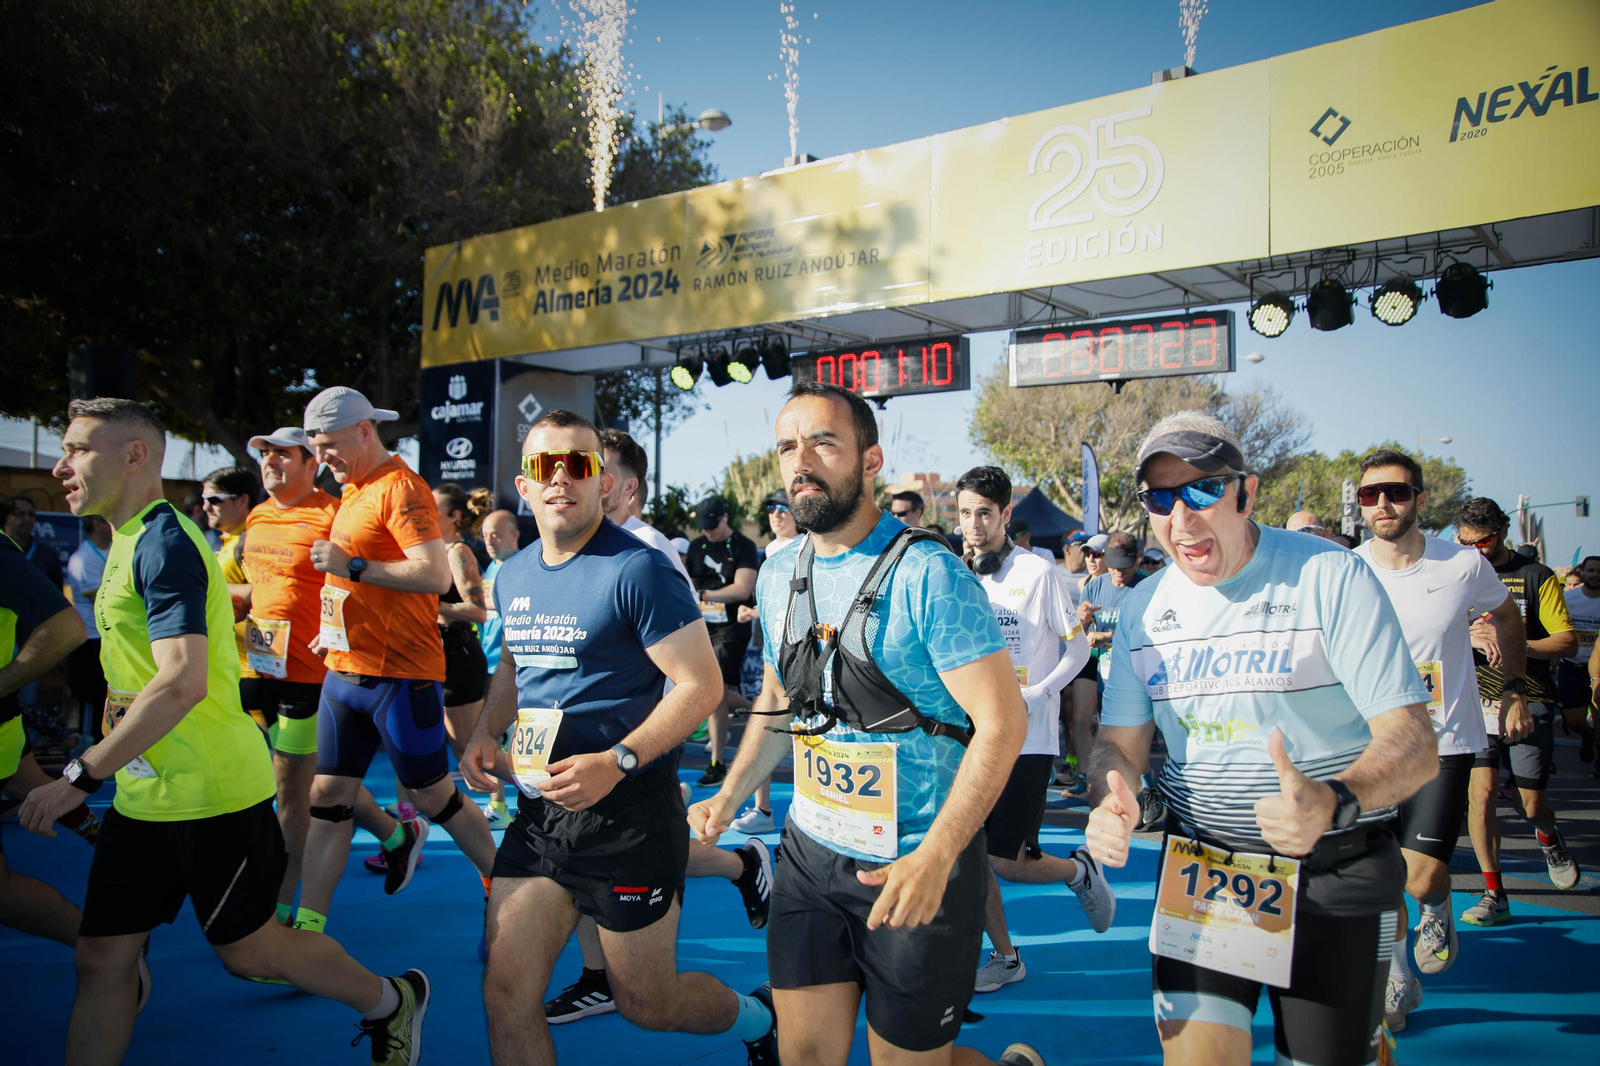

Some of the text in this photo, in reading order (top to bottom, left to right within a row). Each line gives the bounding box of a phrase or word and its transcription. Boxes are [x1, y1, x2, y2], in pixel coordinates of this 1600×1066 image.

[1449, 65, 1600, 143] NEXAL
[1460, 127, 1488, 141] 2020
[1309, 135, 1420, 166] COOPERACIÓN
[1028, 105, 1165, 231] 25
[1309, 163, 1345, 179] 2005
[1026, 219, 1164, 267] EDICIÓN
[535, 242, 681, 285] Medio Maratón
[693, 248, 880, 291] RAMÓN RUIZ ANDÚJAR
[533, 269, 681, 315] Almería 2024
[431, 400, 484, 424] cajamar
[505, 613, 577, 626] Medio Maratón
[994, 608, 1019, 616] ratón
[997, 616, 1019, 626] 024
[250, 627, 274, 647] 909
[524, 645, 540, 653] RUIZ
[542, 644, 576, 654] ANDÚJAR
[1184, 645, 1293, 681] MOTRIL
[1167, 680, 1220, 693] DEPORTIVO
[1245, 675, 1293, 686] ÁLAMOS
[803, 748, 883, 798] 1932
[820, 787, 850, 804] DANIEL
[620, 894, 641, 902] MOYA
[1179, 861, 1283, 917] 1292
[1193, 900, 1223, 916] PACO
